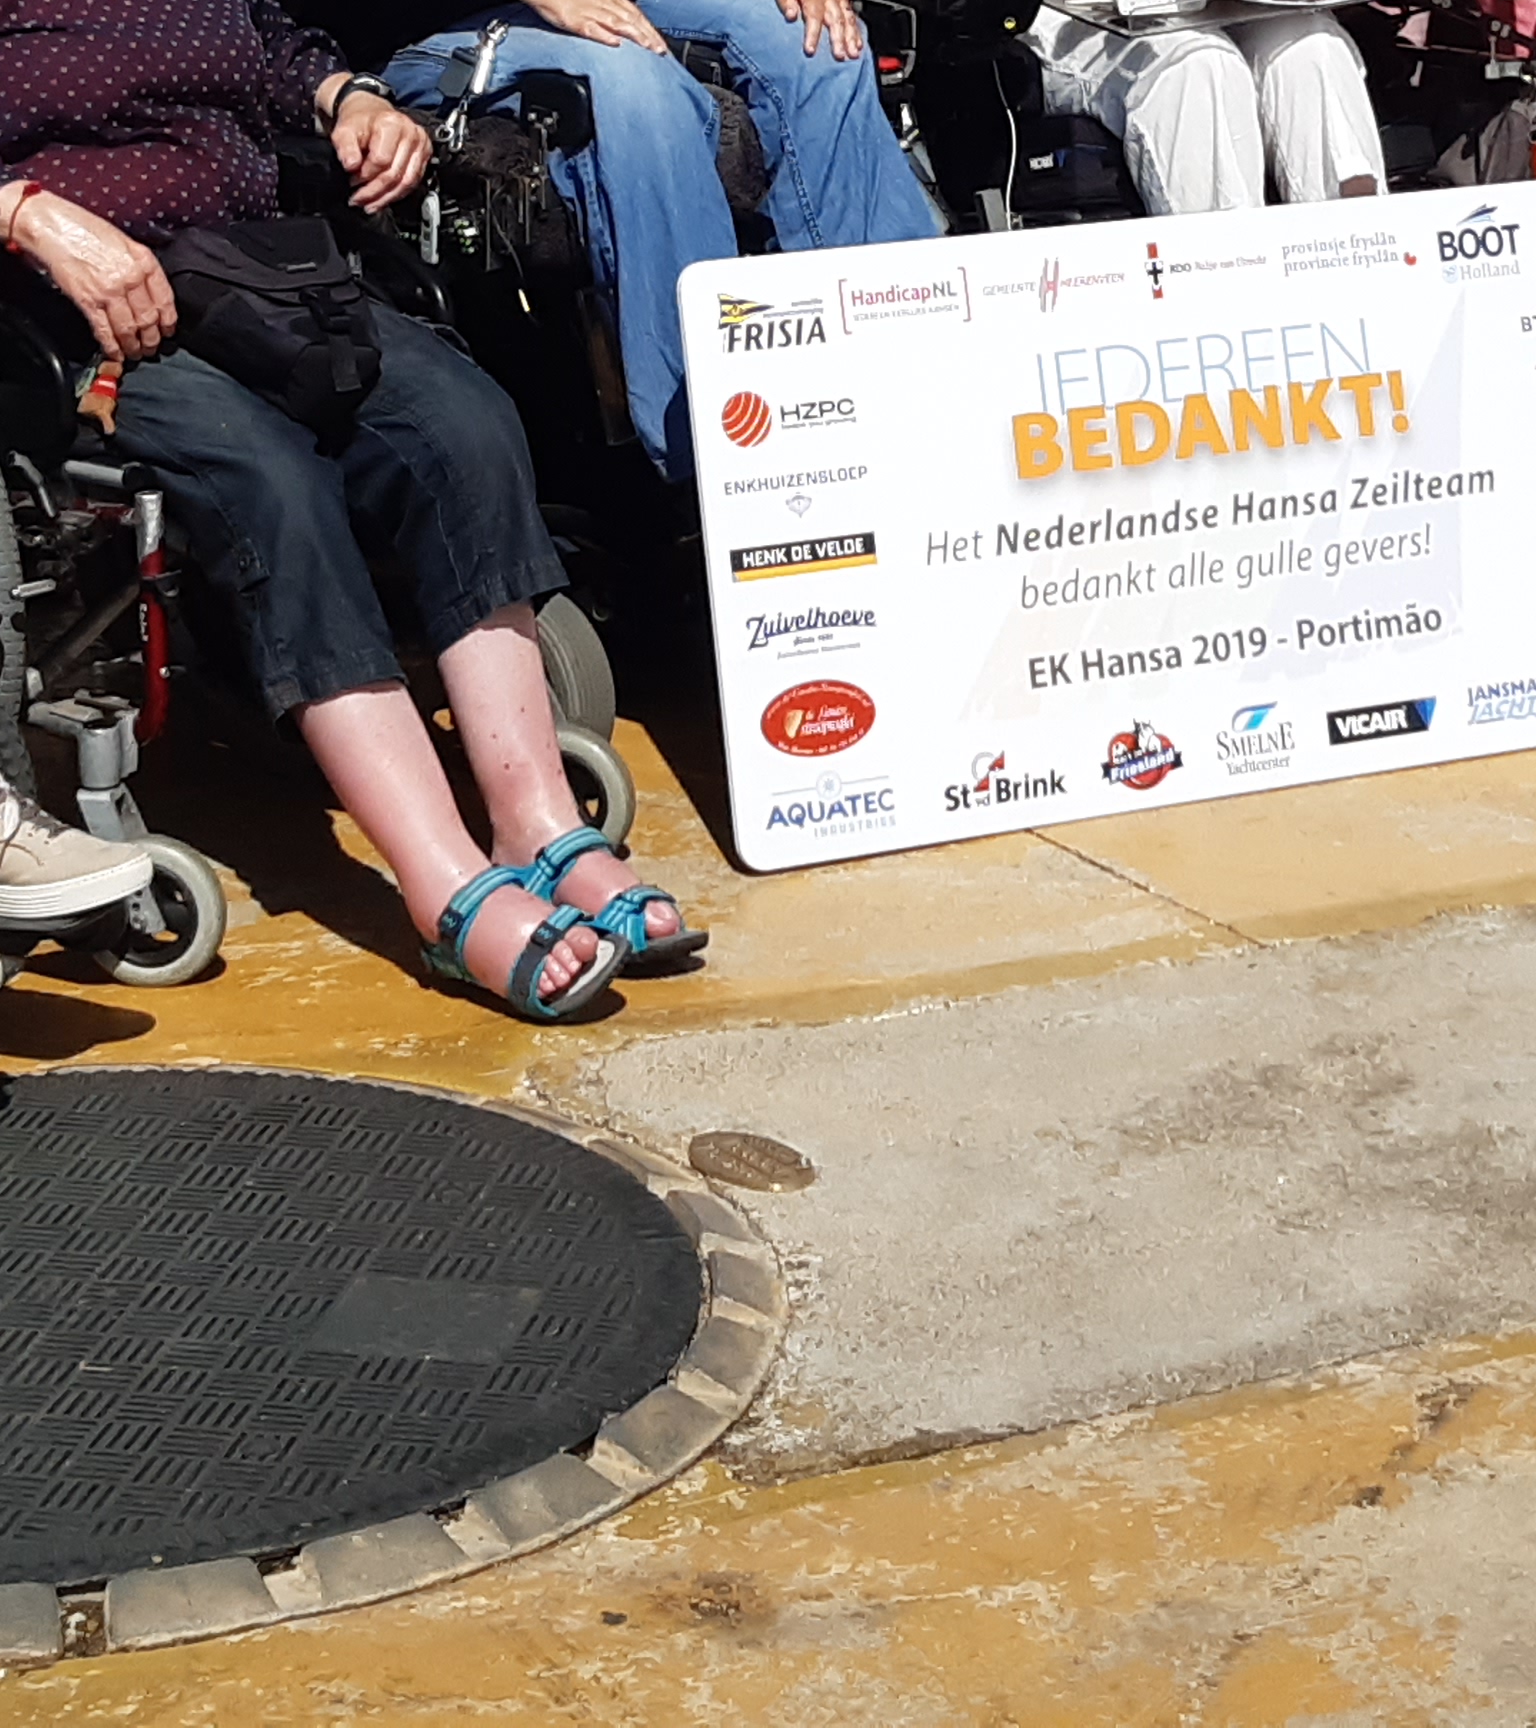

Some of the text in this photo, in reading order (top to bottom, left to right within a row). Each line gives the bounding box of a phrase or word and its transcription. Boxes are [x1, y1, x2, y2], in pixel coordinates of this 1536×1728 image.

[1436, 223, 1520, 263] BOOT
[1460, 260, 1521, 281] Holland
[850, 280, 959, 308] HandicapNL
[726, 316, 827, 354] FRISIA
[1035, 317, 1371, 415] IEDEREEN
[779, 397, 856, 423] HZPC
[1010, 369, 1411, 480] BEDANKT!
[926, 468, 1495, 566] Het Nederlandse Hansa Zeilteam
[742, 536, 865, 569] HENK DE VELDE
[1020, 522, 1432, 610] bedankt alle gulle gevers!
[745, 606, 877, 652] Zuivelhoeve
[1028, 652, 1074, 690] EK
[1080, 644, 1183, 682] Hansa
[1191, 626, 1268, 666] 2019
[1295, 601, 1443, 651] Portimão
[765, 787, 896, 832] AQUATEC
[944, 783, 972, 812] St
[995, 768, 1068, 805] Brink
